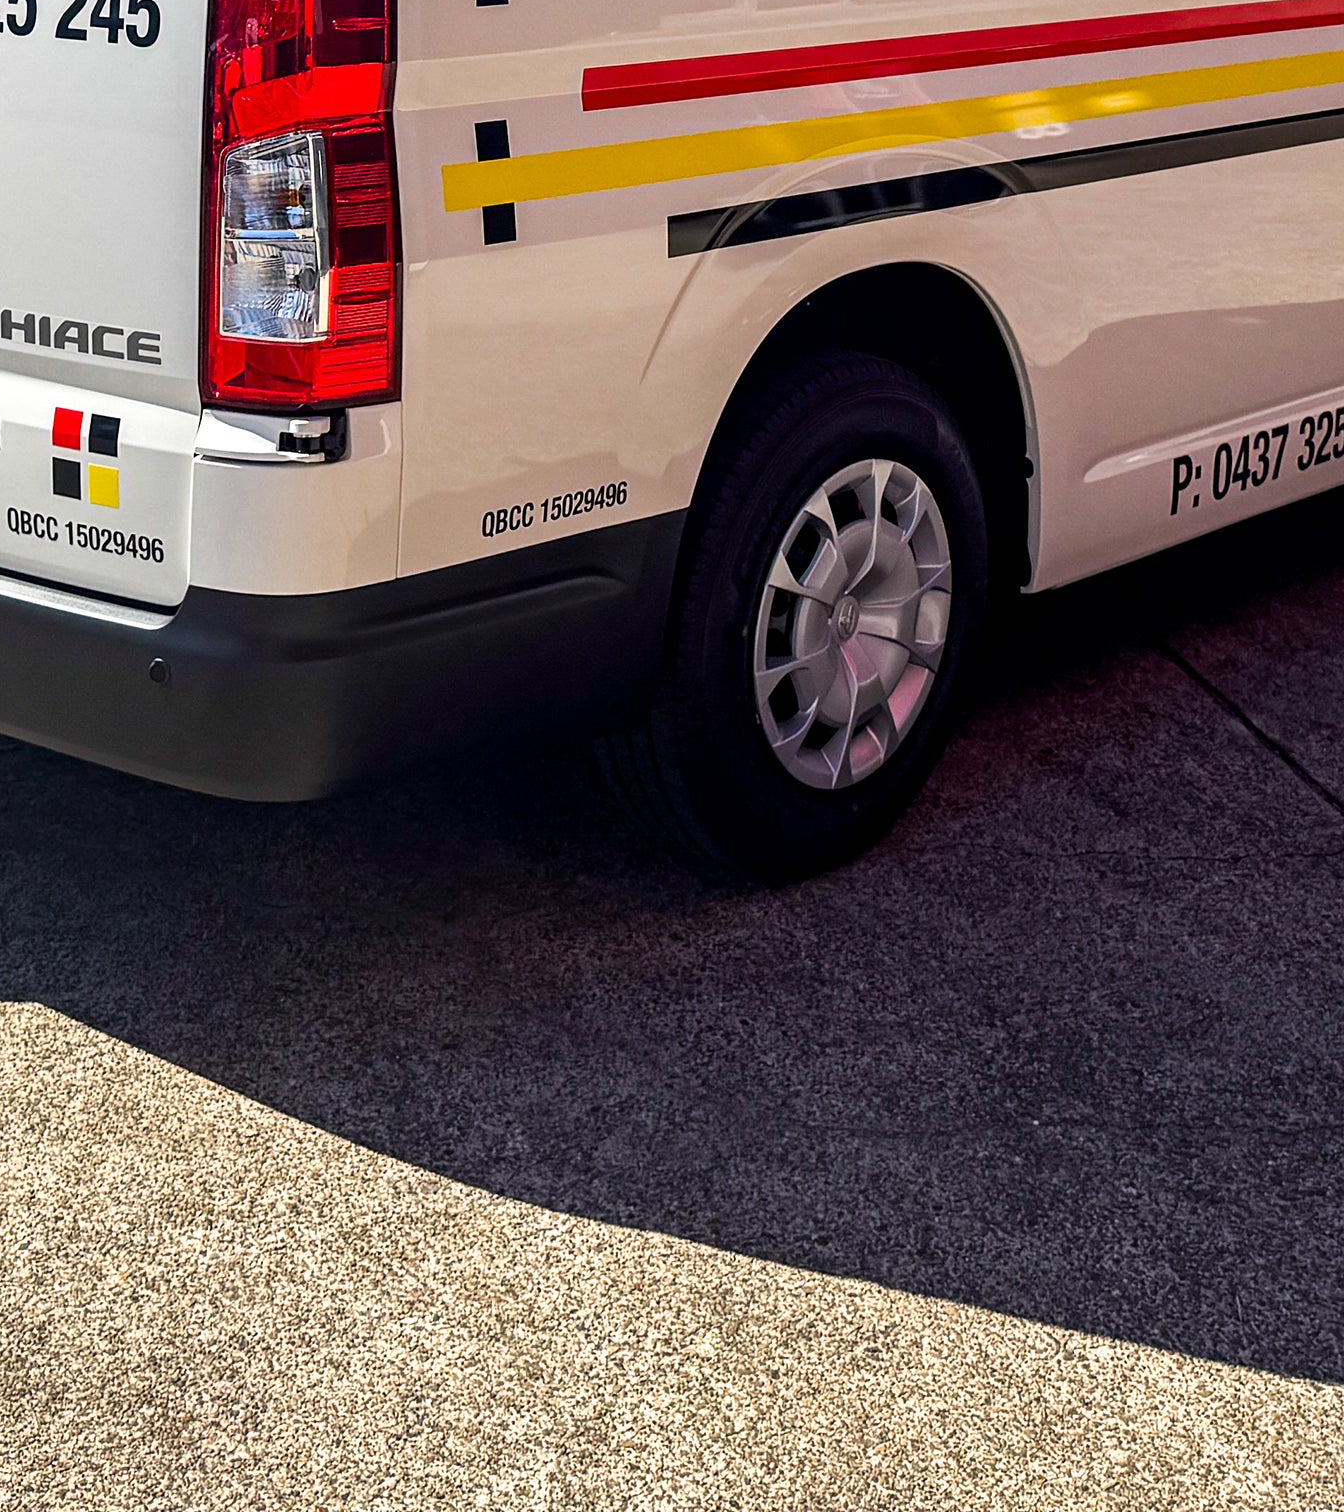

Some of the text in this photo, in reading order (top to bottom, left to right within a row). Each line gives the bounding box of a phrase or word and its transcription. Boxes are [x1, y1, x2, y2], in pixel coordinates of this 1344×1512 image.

[0, 309, 162, 365] HIACE
[1170, 454, 1202, 516] P:
[1213, 423, 1289, 500] 0437
[7, 507, 165, 563] QBCC 15029496
[482, 481, 627, 538] QBCC 15029496
